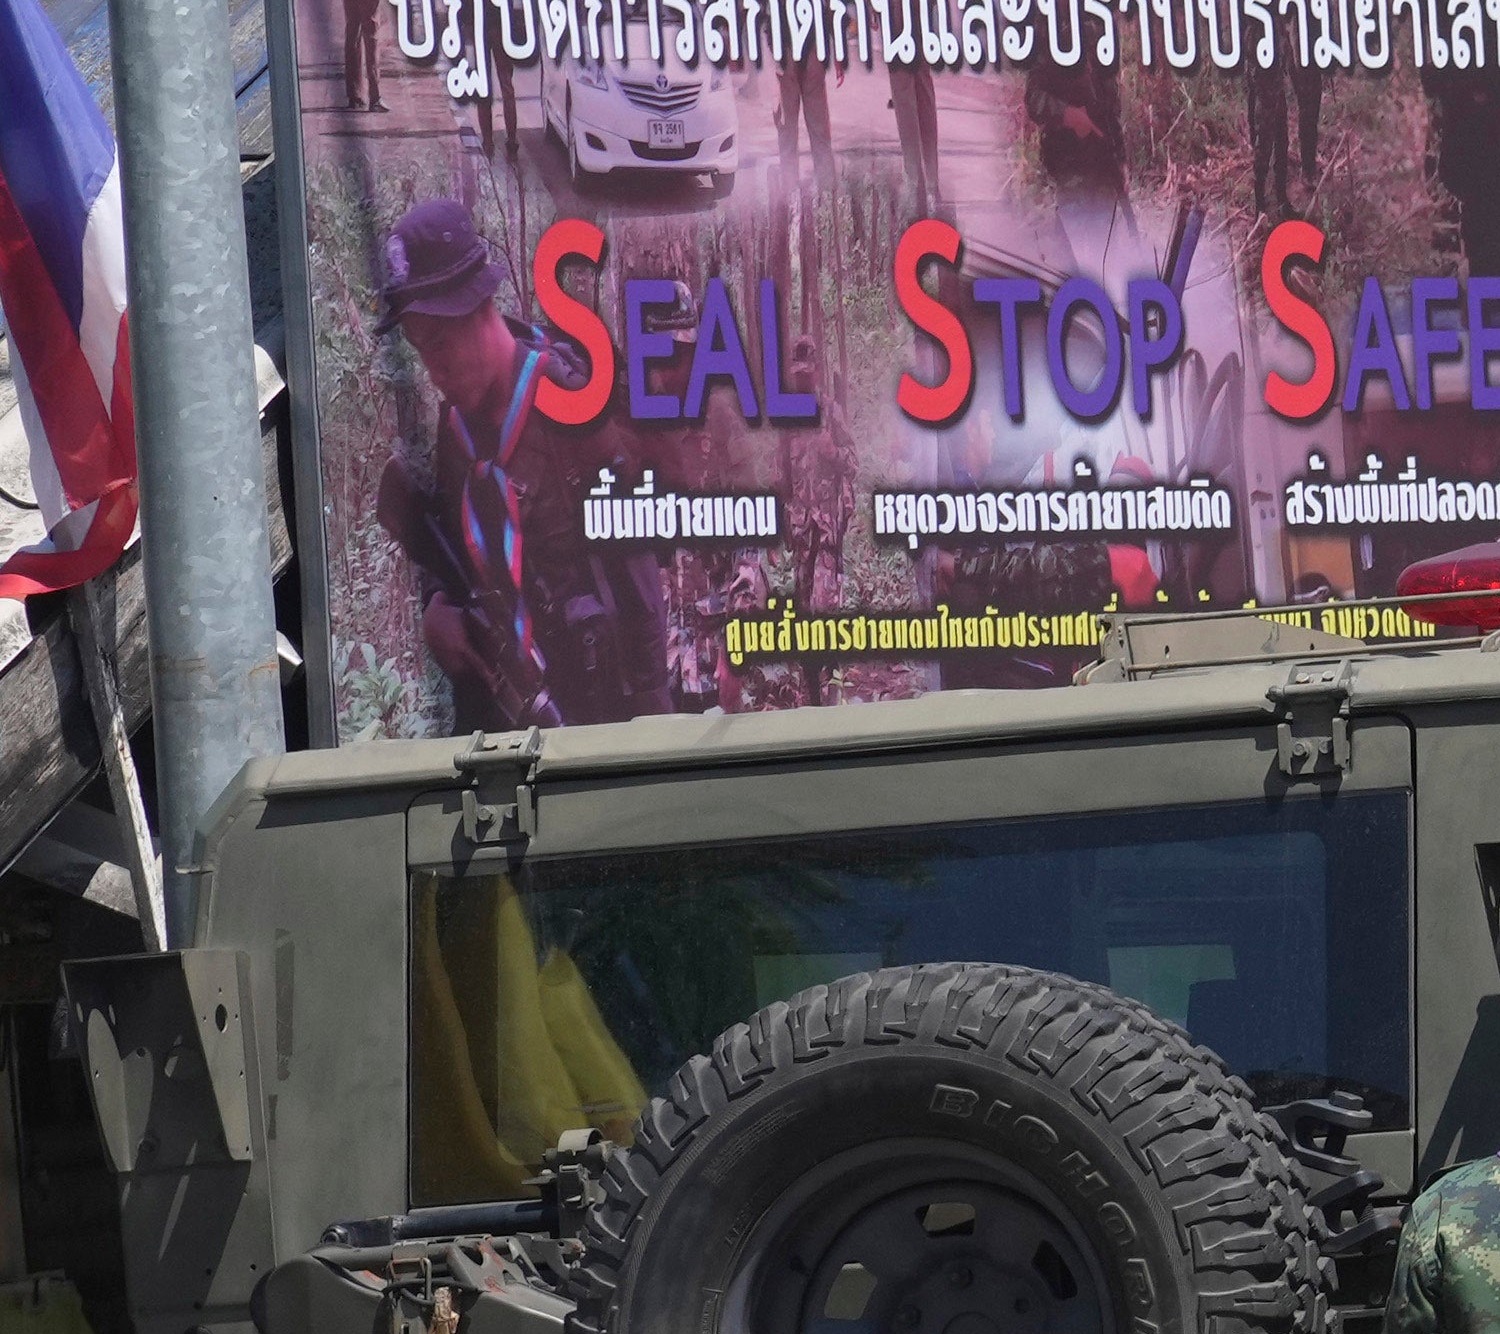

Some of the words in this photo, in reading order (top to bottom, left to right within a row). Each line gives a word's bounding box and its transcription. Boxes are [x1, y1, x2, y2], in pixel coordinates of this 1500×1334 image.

[533, 218, 817, 425] SEAL
[894, 218, 1183, 422] STOP
[584, 467, 778, 541] พื้นที่ชายแดน
[874, 460, 1232, 550] หยุดวงจรการค้ายาเสพติด
